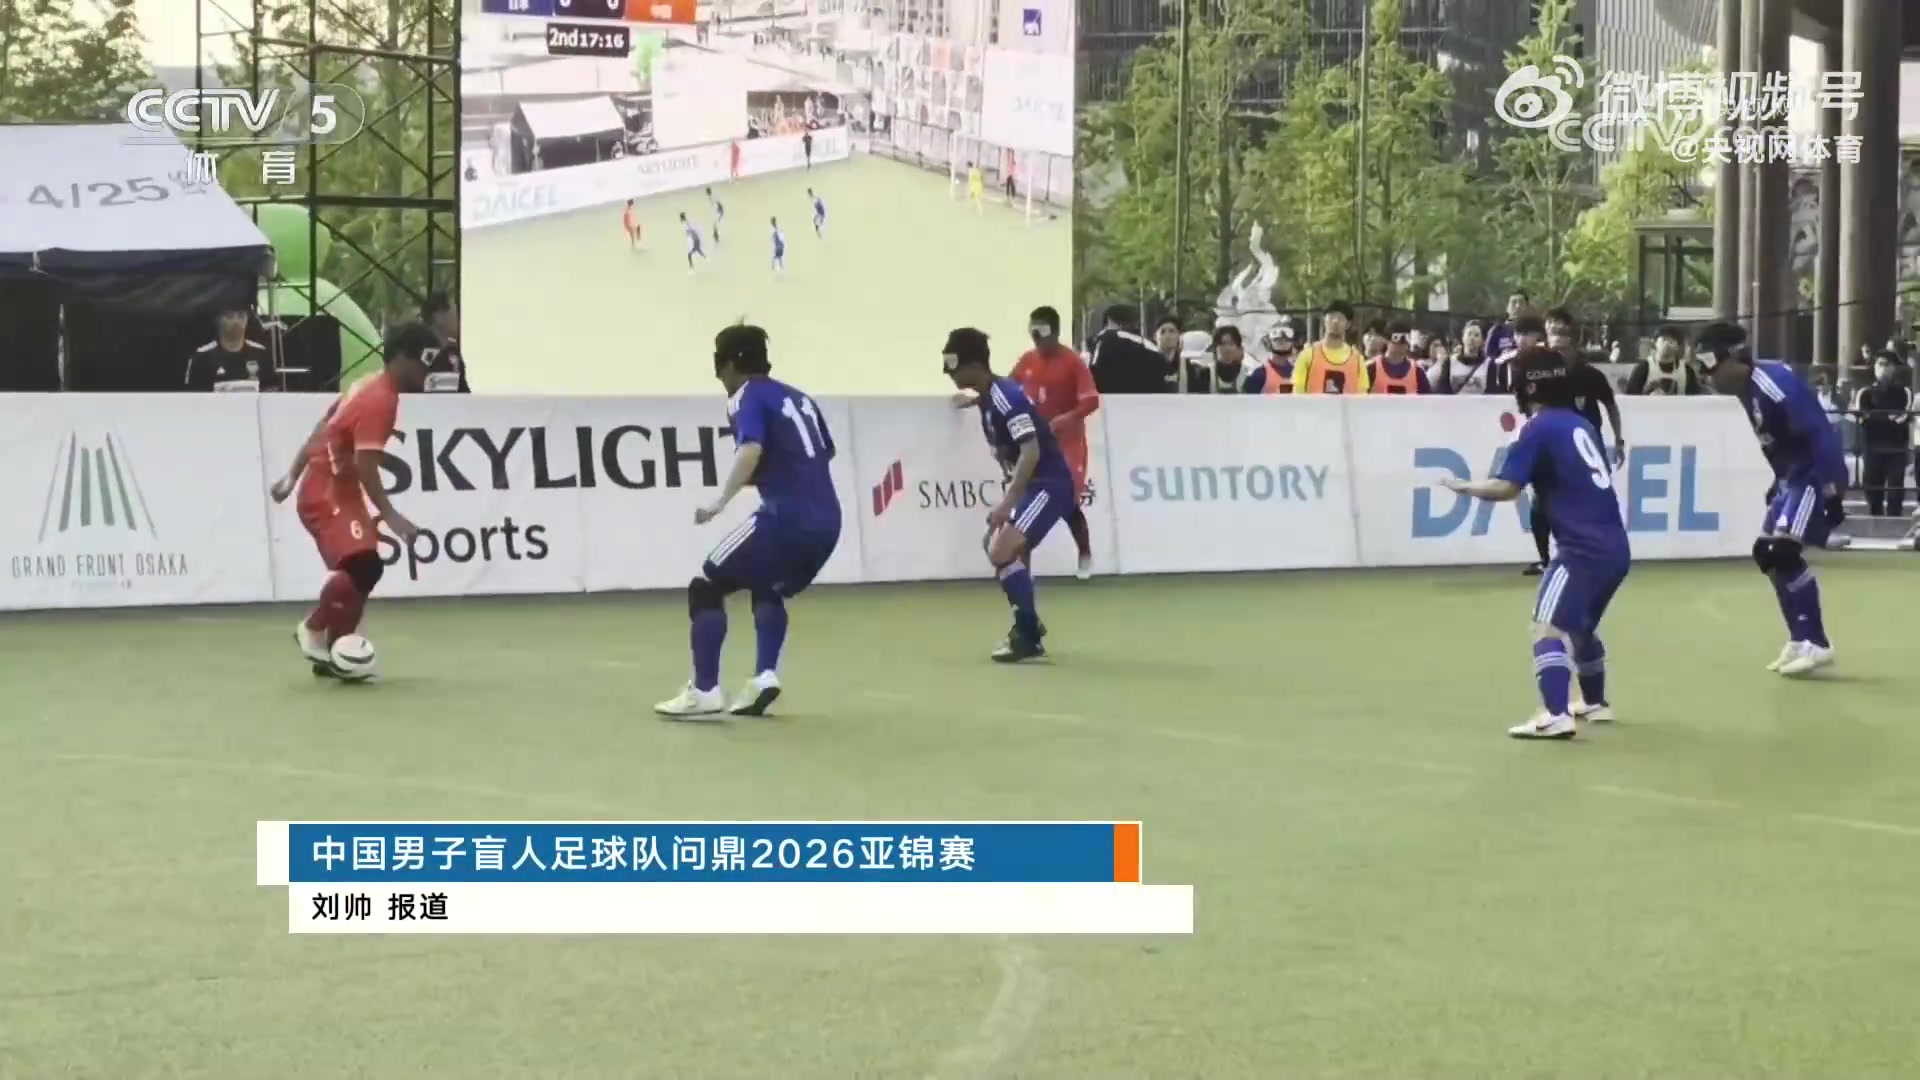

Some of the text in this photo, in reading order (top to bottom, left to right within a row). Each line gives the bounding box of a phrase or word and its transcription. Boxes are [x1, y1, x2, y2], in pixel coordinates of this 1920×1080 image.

[550, 28, 578, 46] 2nd
[782, 395, 828, 458] 11
[1572, 426, 1611, 490] 9
[918, 479, 995, 509] SMBC
[1130, 464, 1329, 502] SUNTORY
[1411, 445, 1719, 538] DAEL
[350, 519, 363, 540] 6
[11, 551, 188, 579] GRAND FRONT OSAKA
